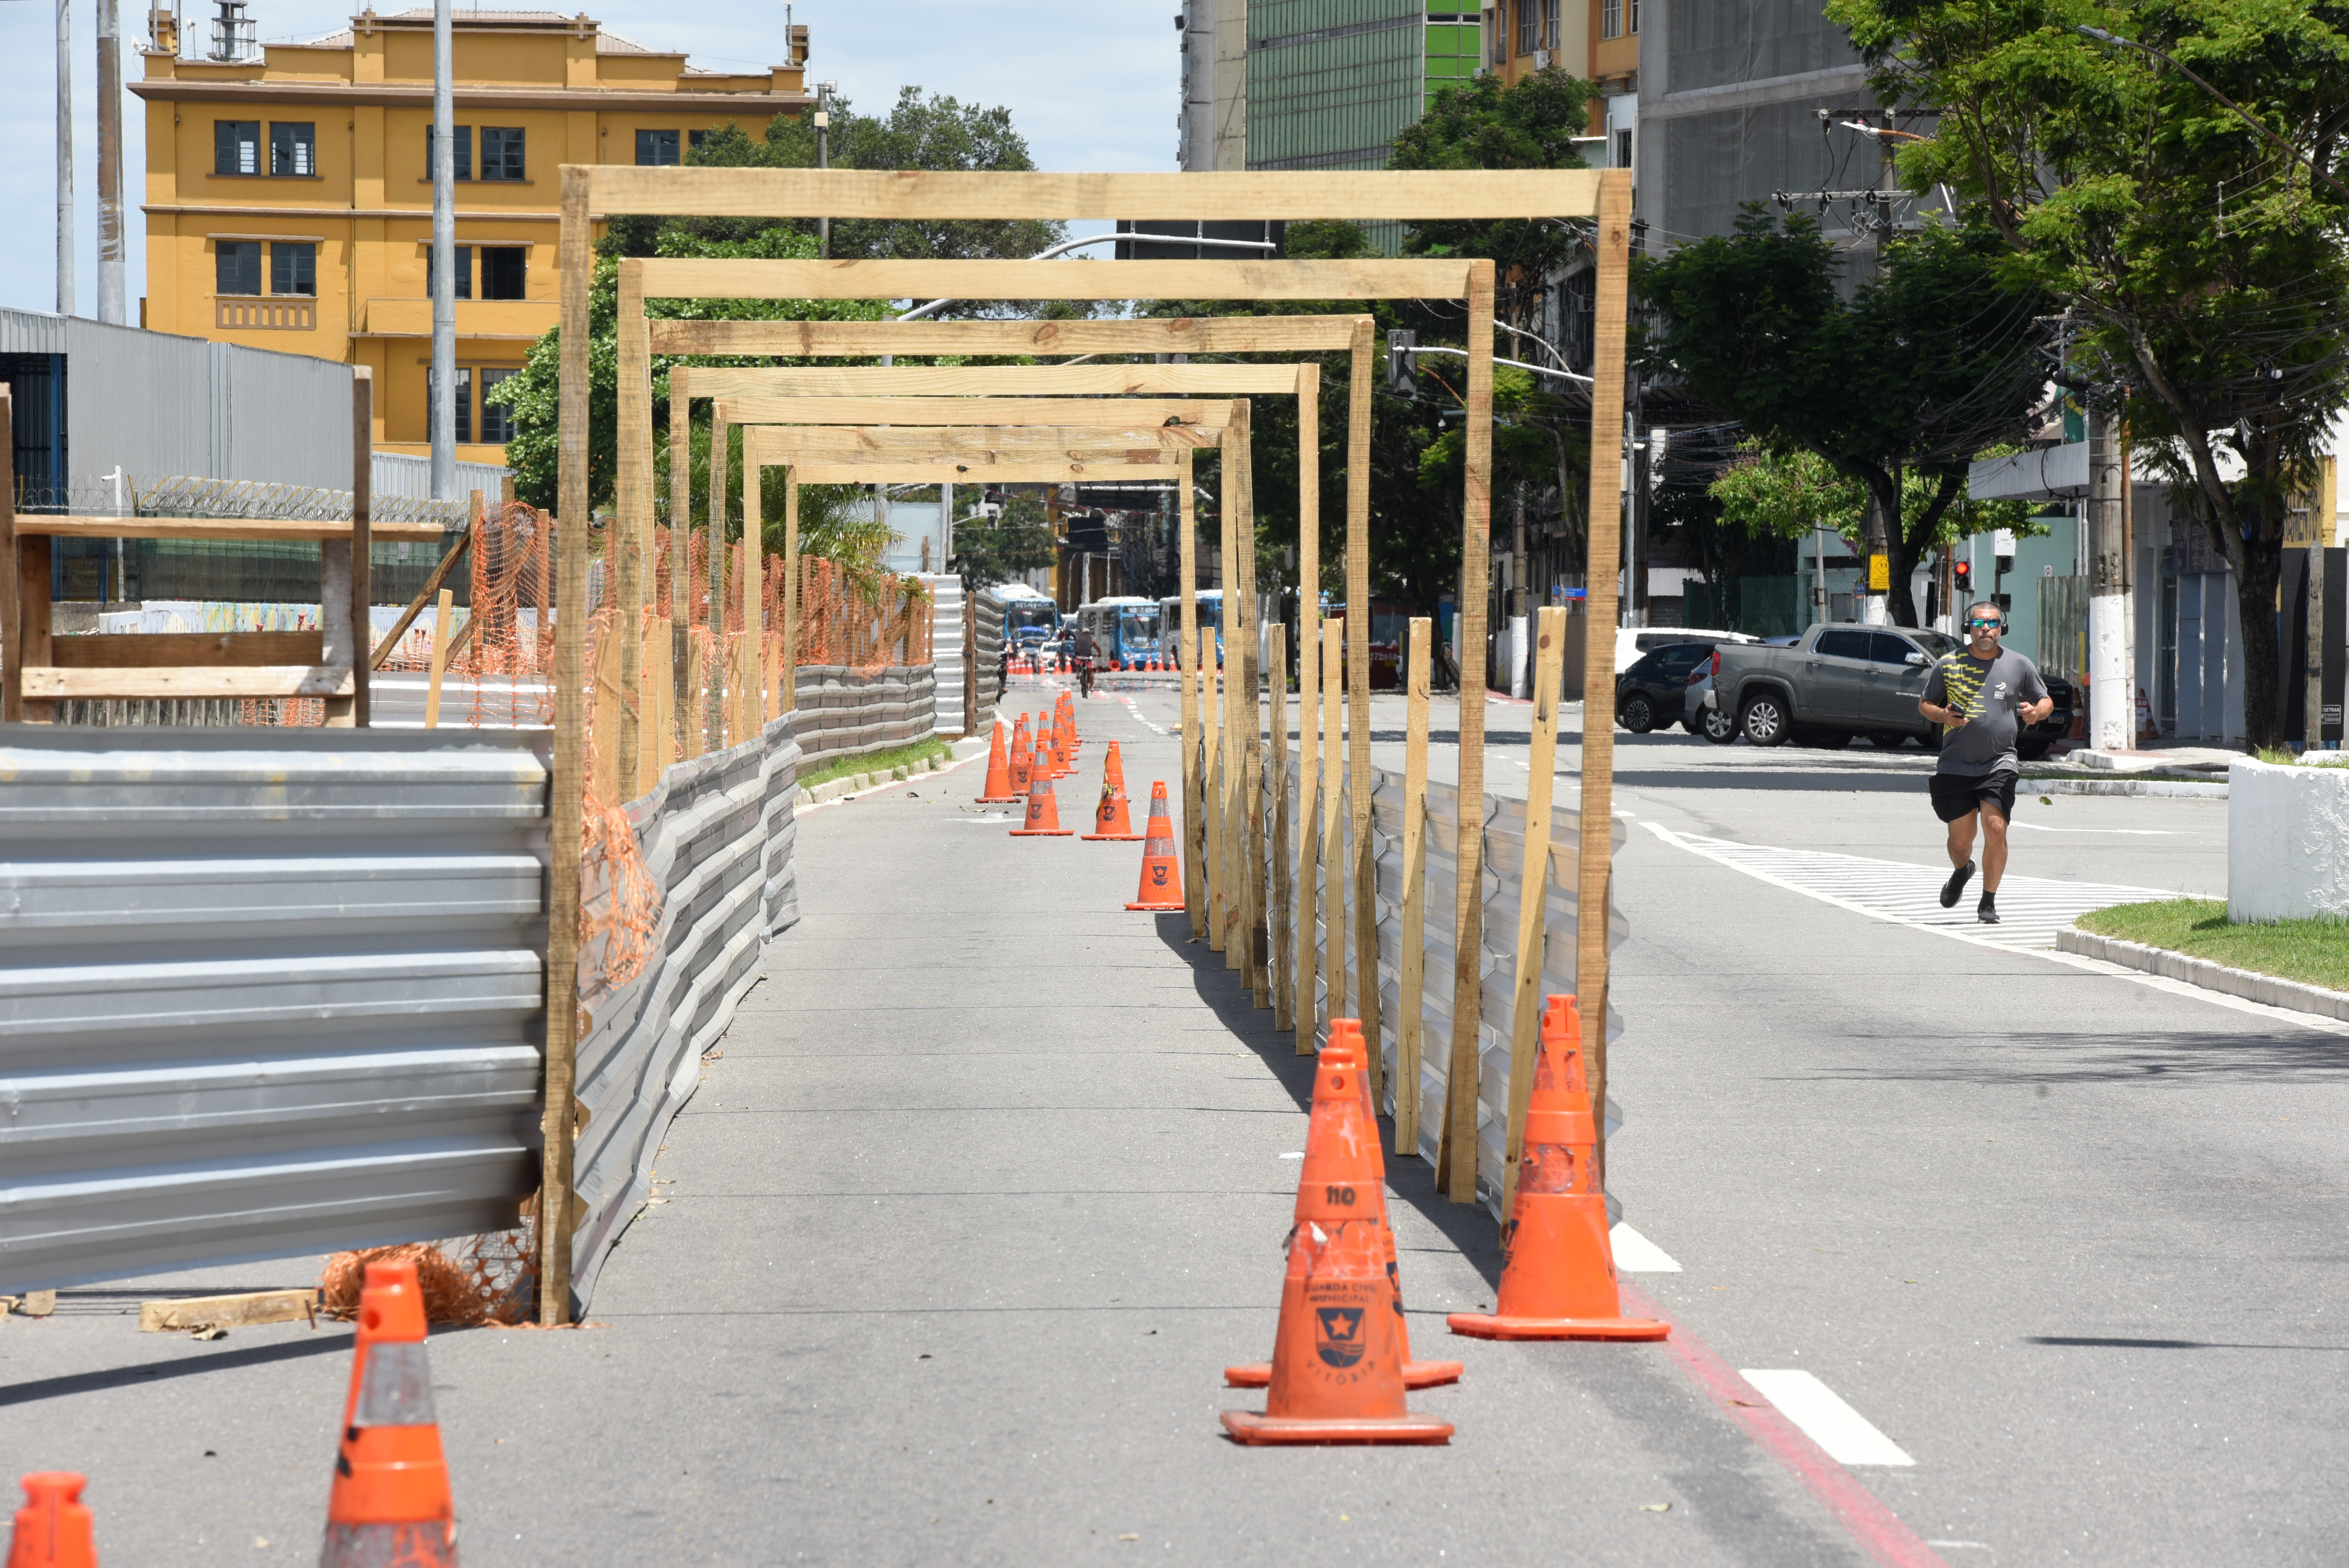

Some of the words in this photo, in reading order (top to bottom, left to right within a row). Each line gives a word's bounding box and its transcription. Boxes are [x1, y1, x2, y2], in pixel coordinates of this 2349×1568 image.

[1326, 1185, 1356, 1206] 110
[1304, 1283, 1348, 1292] GUARDA
[1352, 1283, 1376, 1293] CIVIL
[1310, 1294, 1369, 1303] MUNICIPAL
